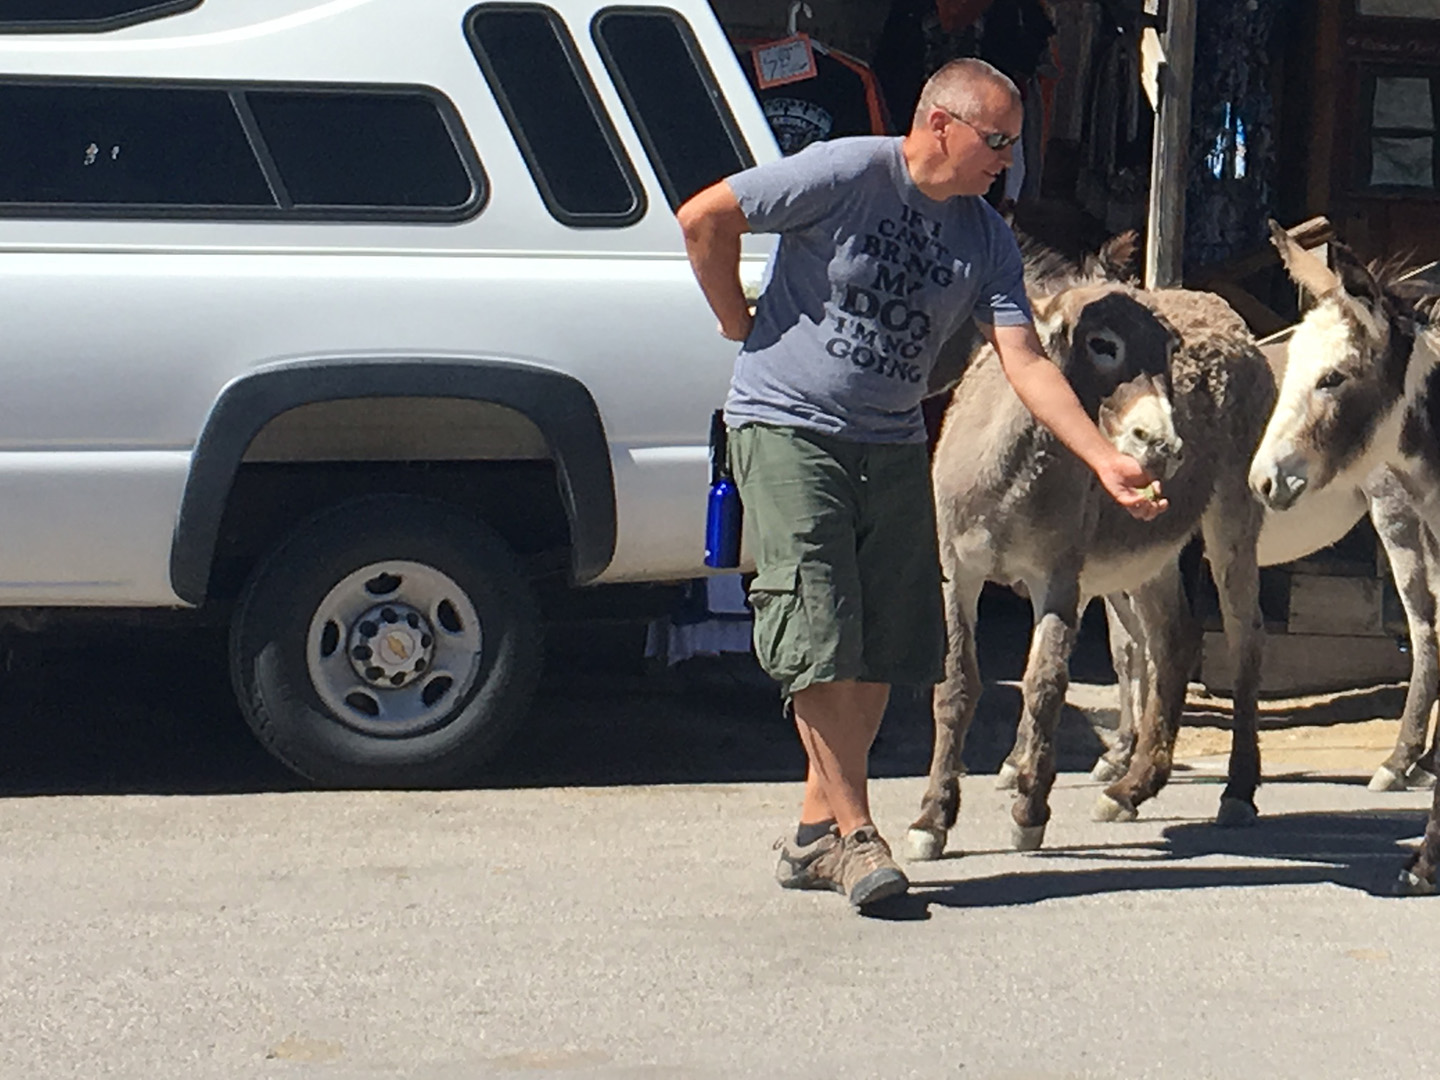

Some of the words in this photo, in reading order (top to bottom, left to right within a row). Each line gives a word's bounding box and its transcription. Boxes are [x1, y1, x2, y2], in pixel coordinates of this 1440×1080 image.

[901, 204, 923, 228] IF
[860, 234, 954, 288] BRNG
[834, 316, 878, 347] I'M
[825, 337, 922, 384] GOING
